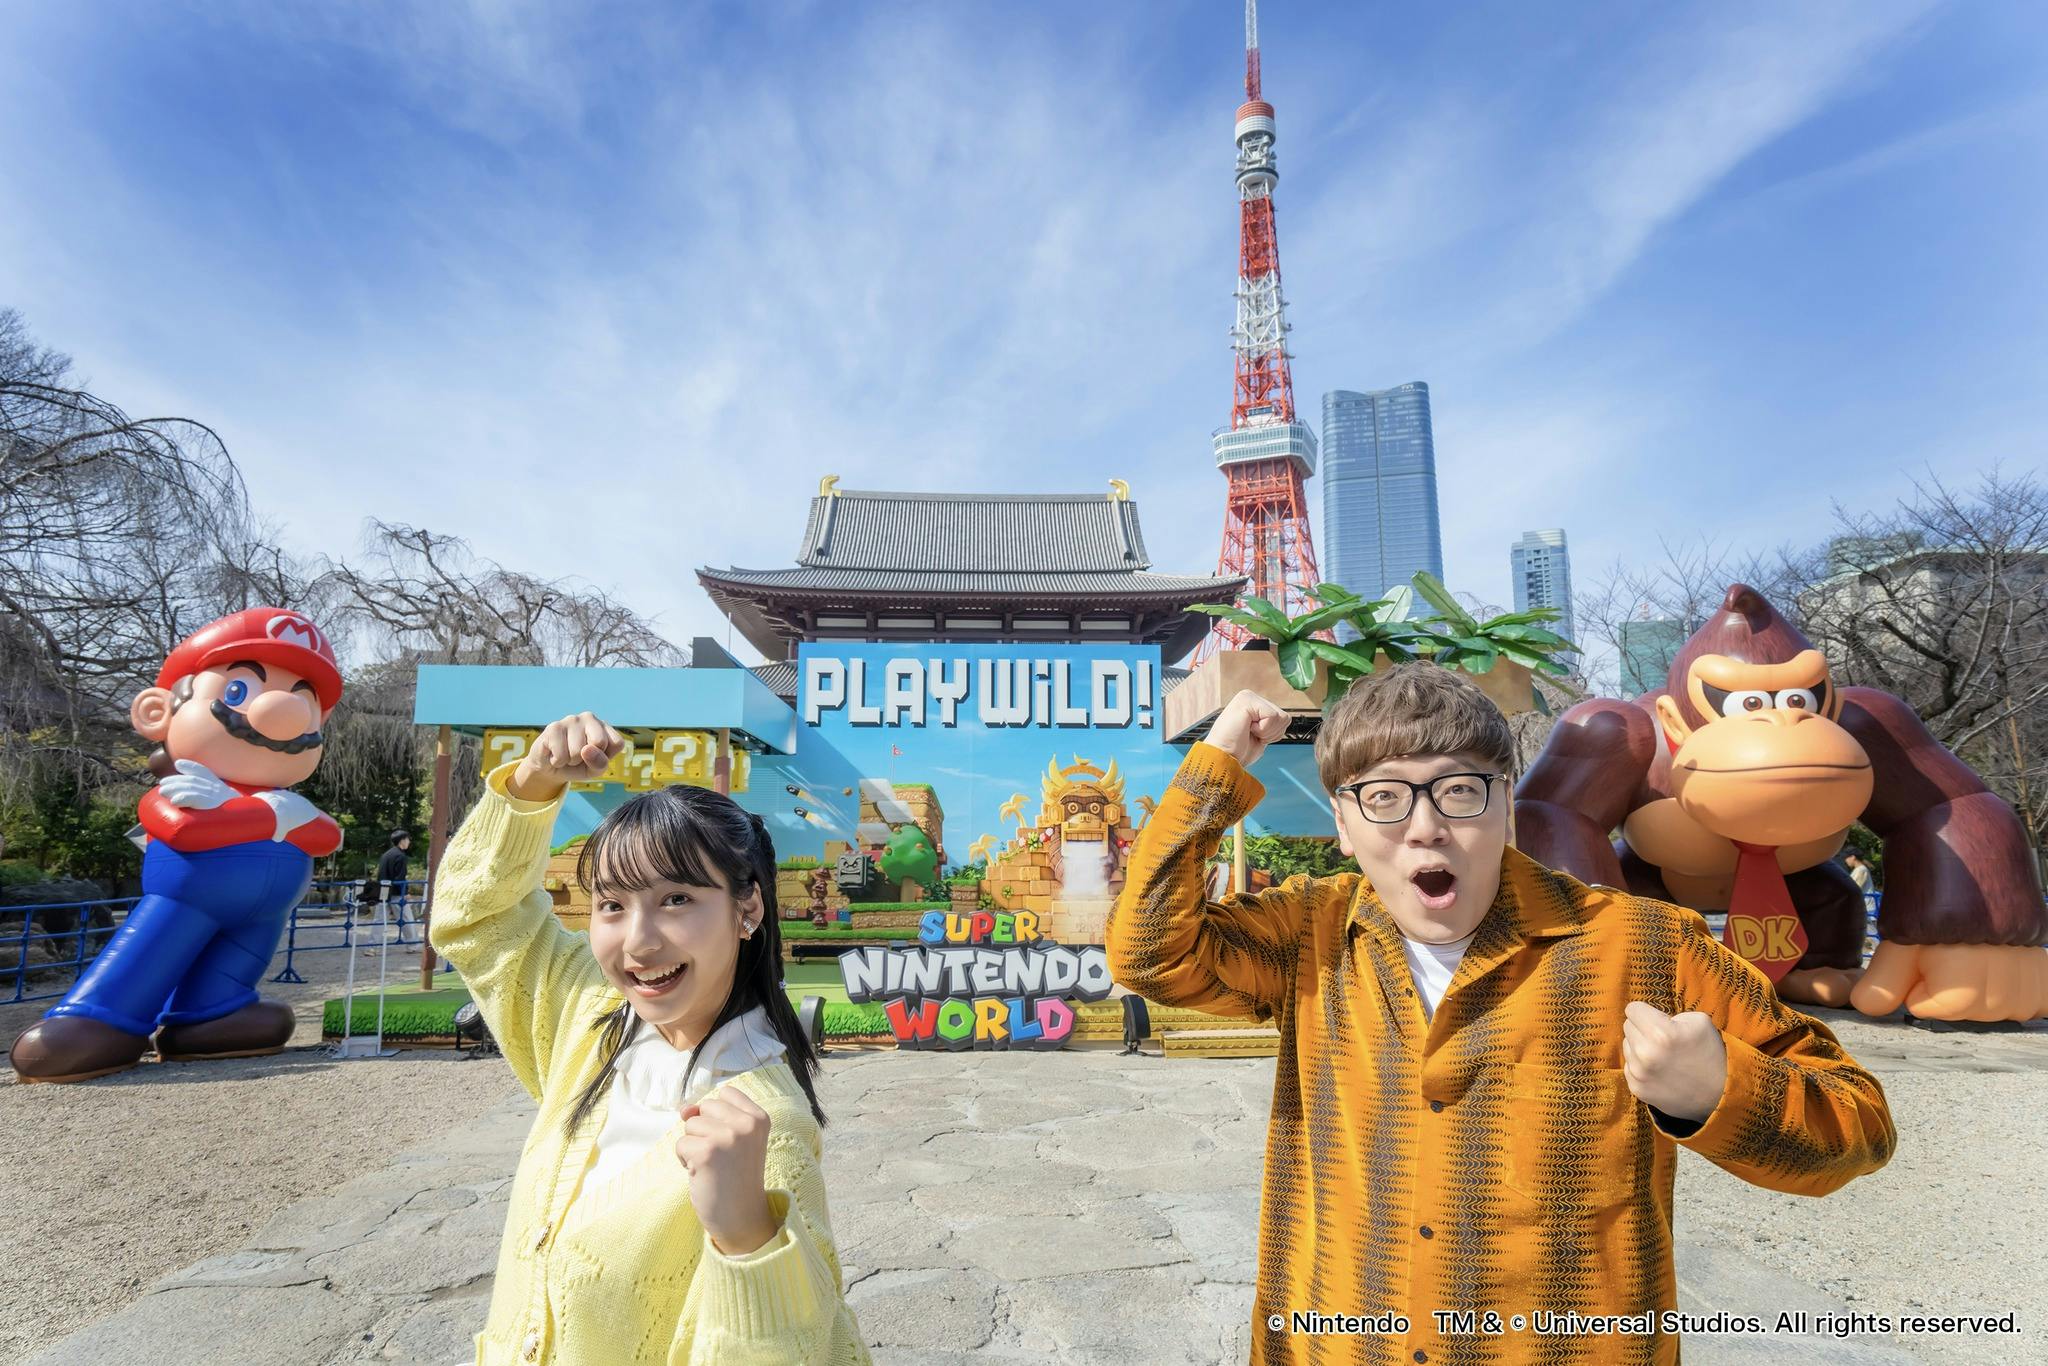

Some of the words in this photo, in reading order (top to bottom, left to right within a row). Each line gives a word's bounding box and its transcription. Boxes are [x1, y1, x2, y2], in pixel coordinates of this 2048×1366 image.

[805, 657, 970, 729] PLAY
[918, 910, 1043, 945] SUPER
[1729, 914, 1801, 961] DK
[839, 946, 1114, 1003] NINTENDO
[882, 995, 1075, 1050] WORLD
